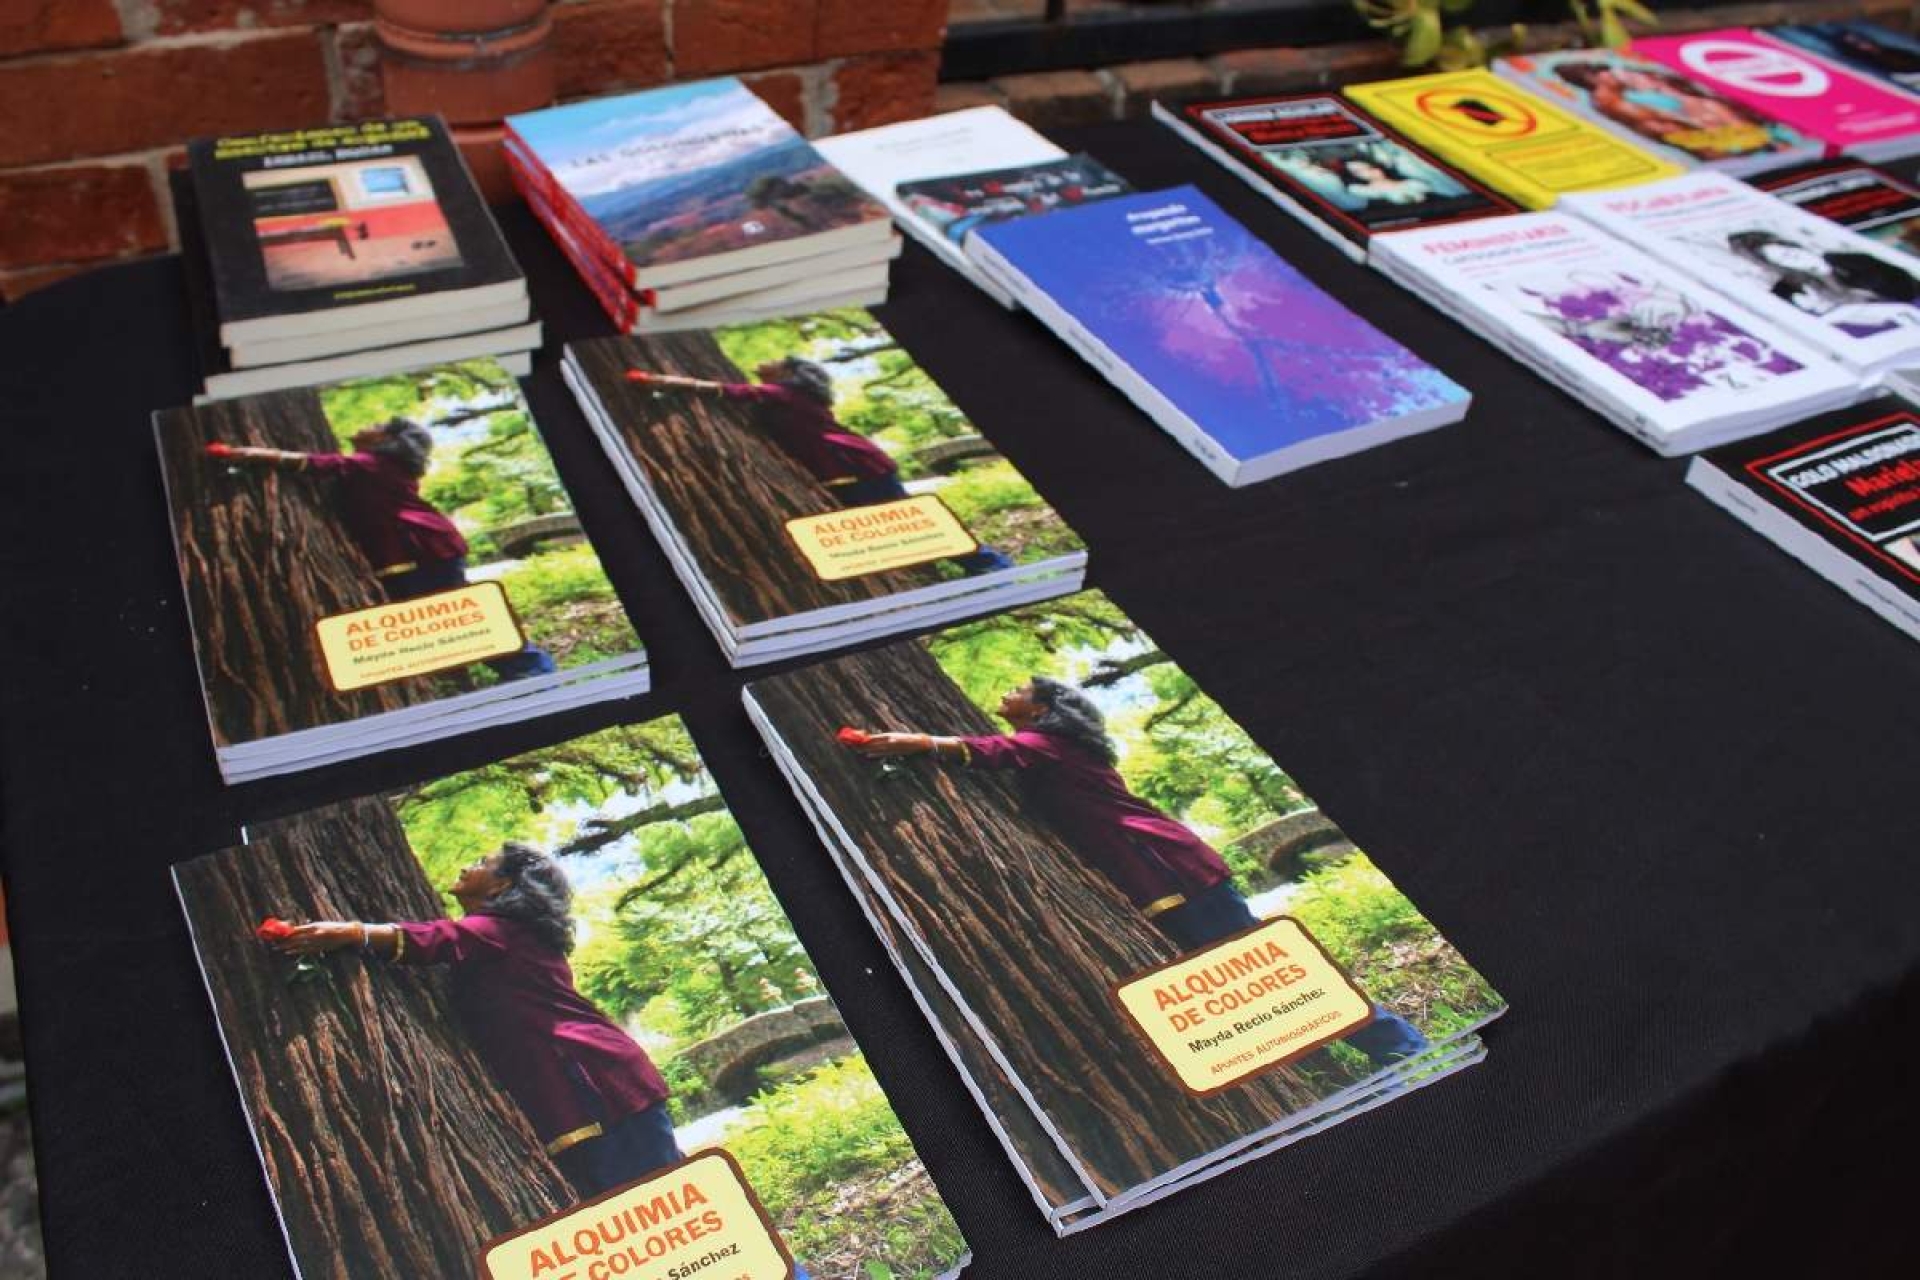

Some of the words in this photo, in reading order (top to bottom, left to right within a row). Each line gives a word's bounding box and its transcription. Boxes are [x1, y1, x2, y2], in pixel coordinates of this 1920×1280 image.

[813, 505, 924, 536] ALQUIMIA
[818, 536, 845, 549] DE
[850, 518, 936, 543] COLORES
[346, 597, 478, 636] ALQUIMIA
[349, 637, 379, 652] DE
[384, 611, 487, 642] COLORES
[1152, 941, 1290, 1012] ALQUIMIA
[1168, 1007, 1205, 1033] DE
[1204, 964, 1307, 1016] COLORES
[1187, 1028, 1234, 1054] Mayda
[1233, 1012, 1273, 1034] Recio
[1271, 987, 1326, 1017] Sánchez
[530, 1183, 708, 1279] ALQUIMIA
[588, 1210, 724, 1280] COLORES
[667, 1242, 742, 1280] Sánchez
